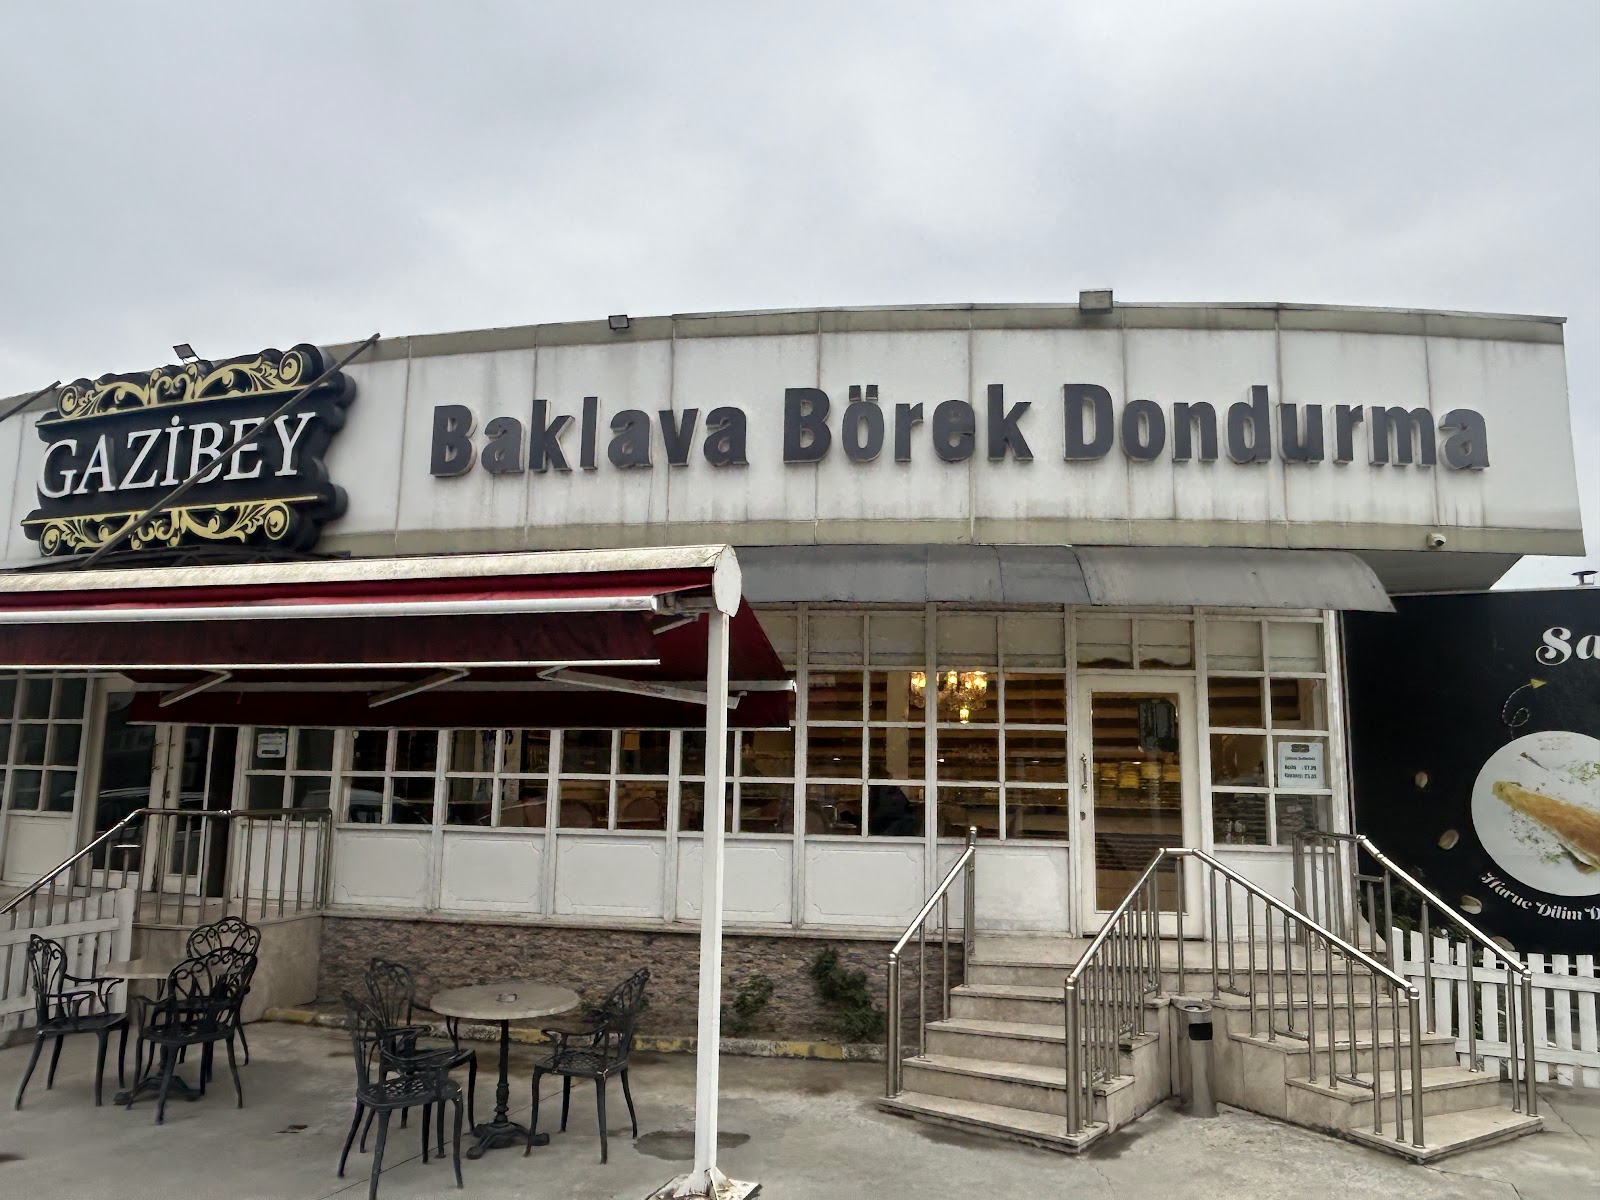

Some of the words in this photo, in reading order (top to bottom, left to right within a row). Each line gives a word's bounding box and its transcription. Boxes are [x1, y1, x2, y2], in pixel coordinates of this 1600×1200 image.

[37, 411, 316, 498] GAZİBEY
[430, 396, 749, 478] Baklava
[783, 383, 1035, 464] Börek
[1063, 383, 1491, 471] Dondurma
[1535, 901, 1583, 920] Dilim
